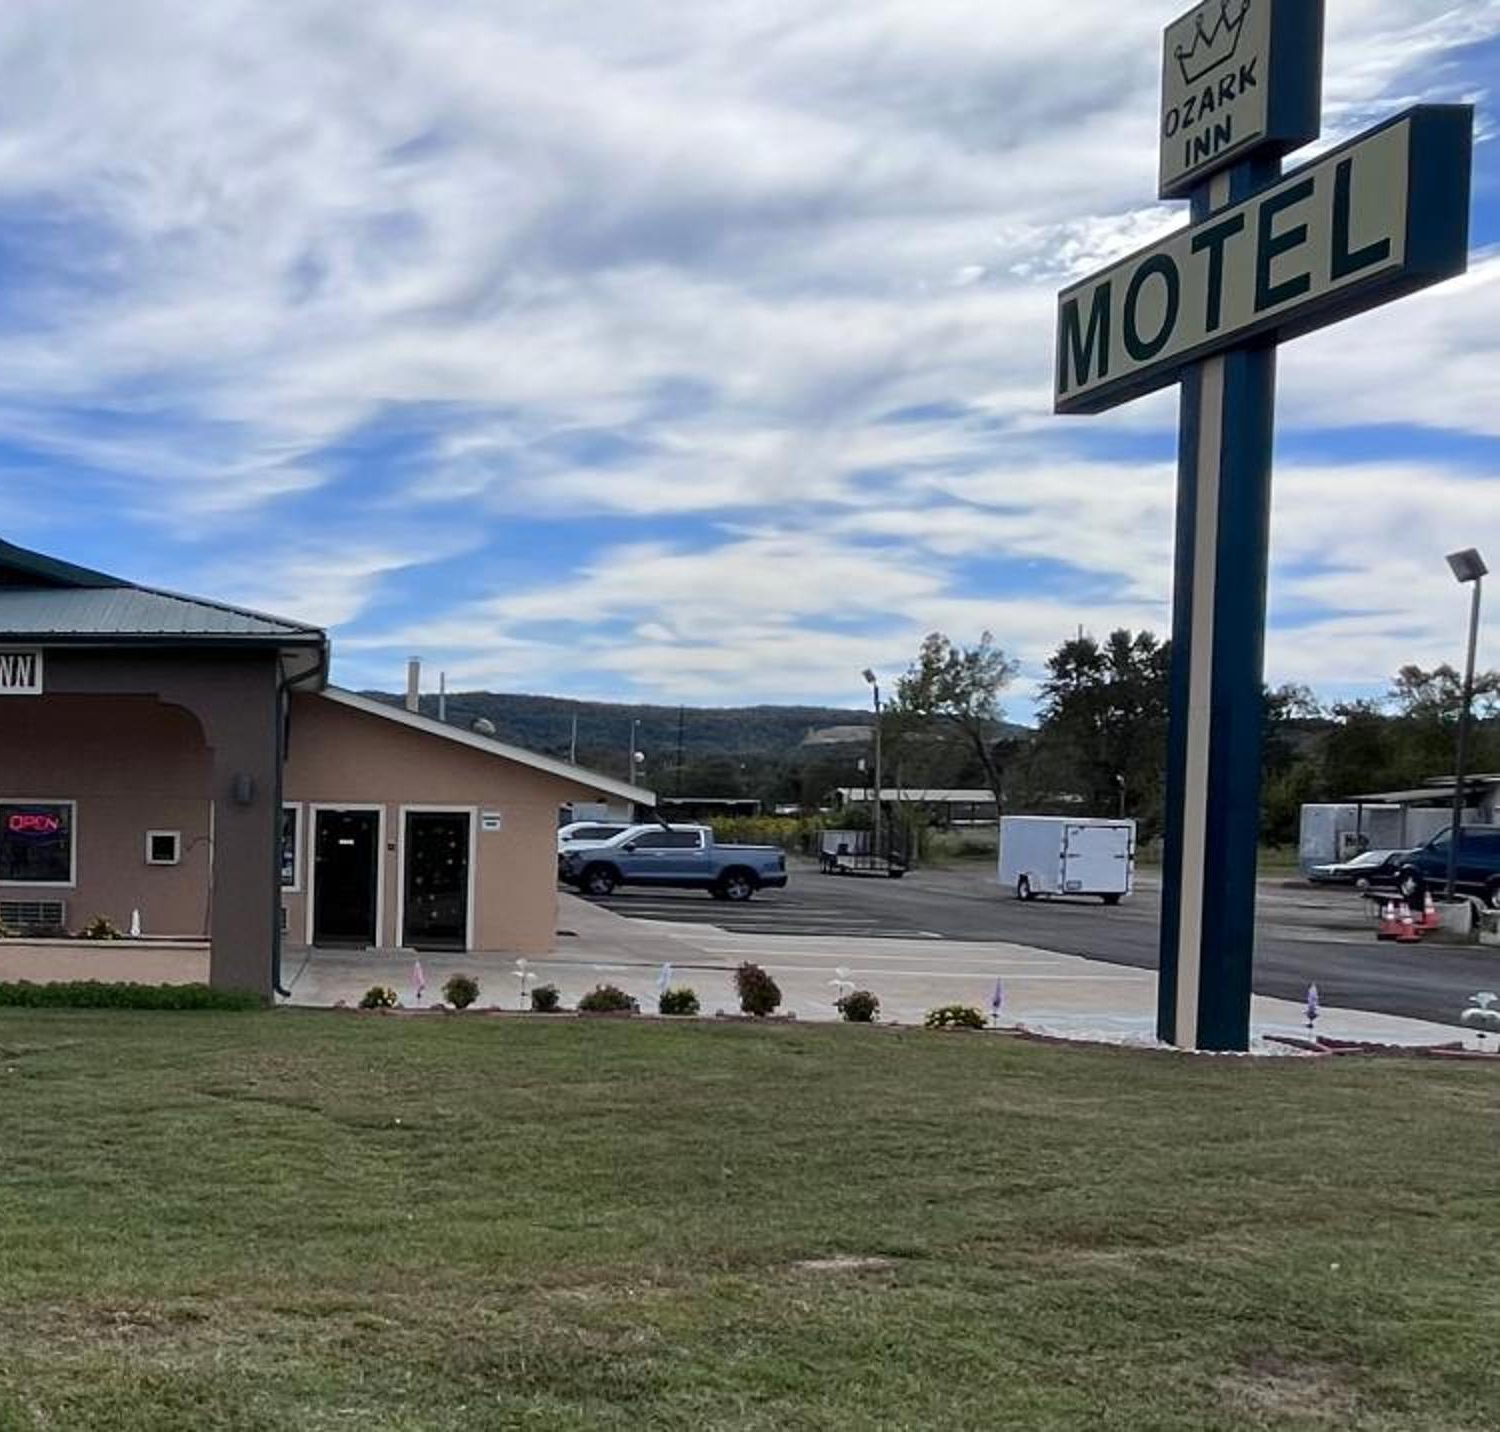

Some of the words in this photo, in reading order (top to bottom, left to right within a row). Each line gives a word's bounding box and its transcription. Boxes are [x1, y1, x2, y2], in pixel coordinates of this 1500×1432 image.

[1165, 57, 1257, 138] OZARK
[1185, 114, 1232, 168] INN
[1059, 157, 1391, 394] MOTEL
[9, 815, 59, 831] OPEN
